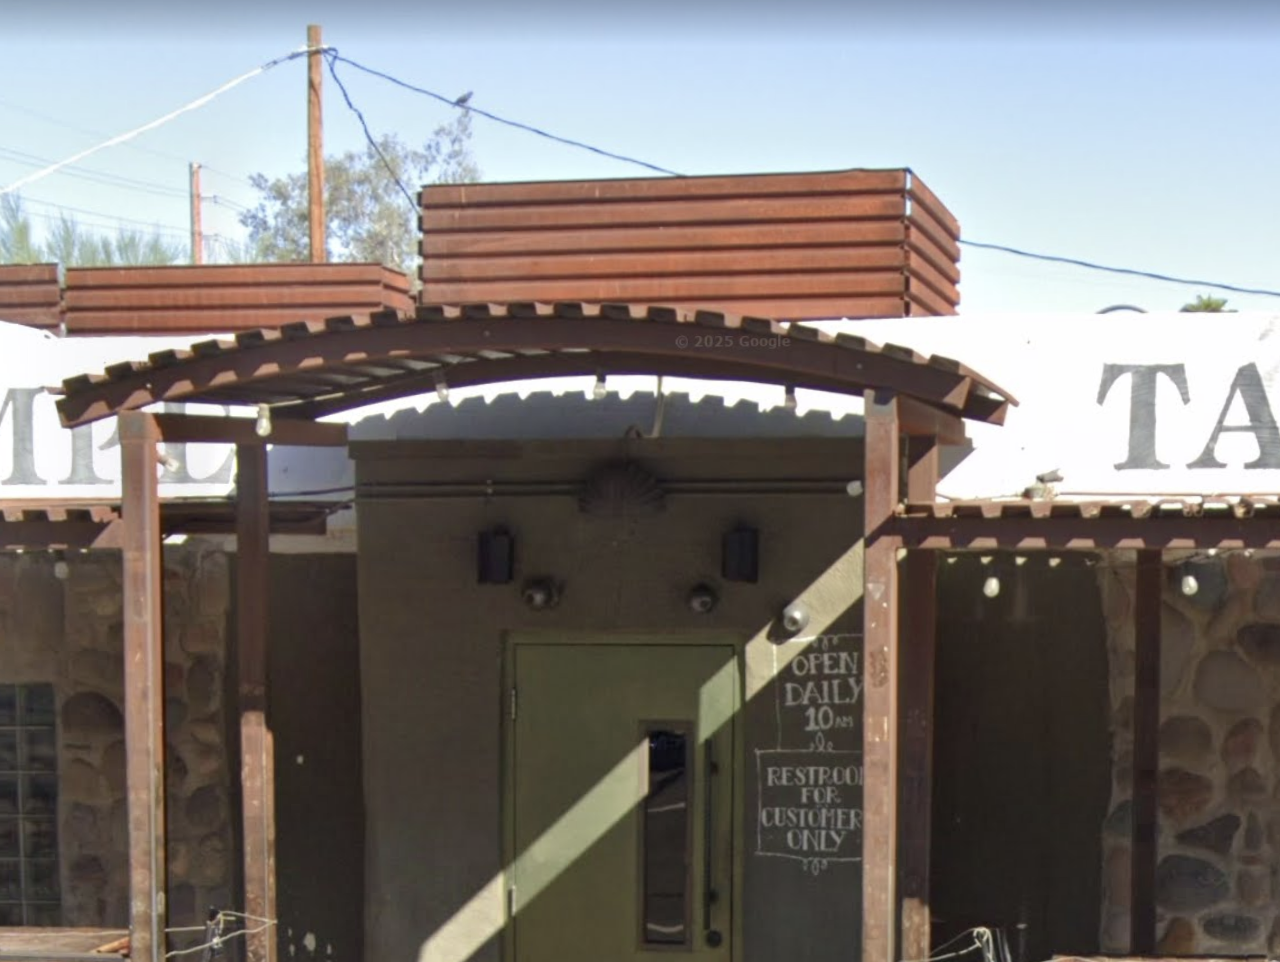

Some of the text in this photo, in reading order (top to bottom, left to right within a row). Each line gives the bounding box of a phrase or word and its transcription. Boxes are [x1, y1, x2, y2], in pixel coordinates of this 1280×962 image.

[791, 651, 859, 676] OPEN
[784, 677, 864, 706] DAILY
[801, 786, 841, 804] FOR
[787, 828, 847, 852] ONLY
